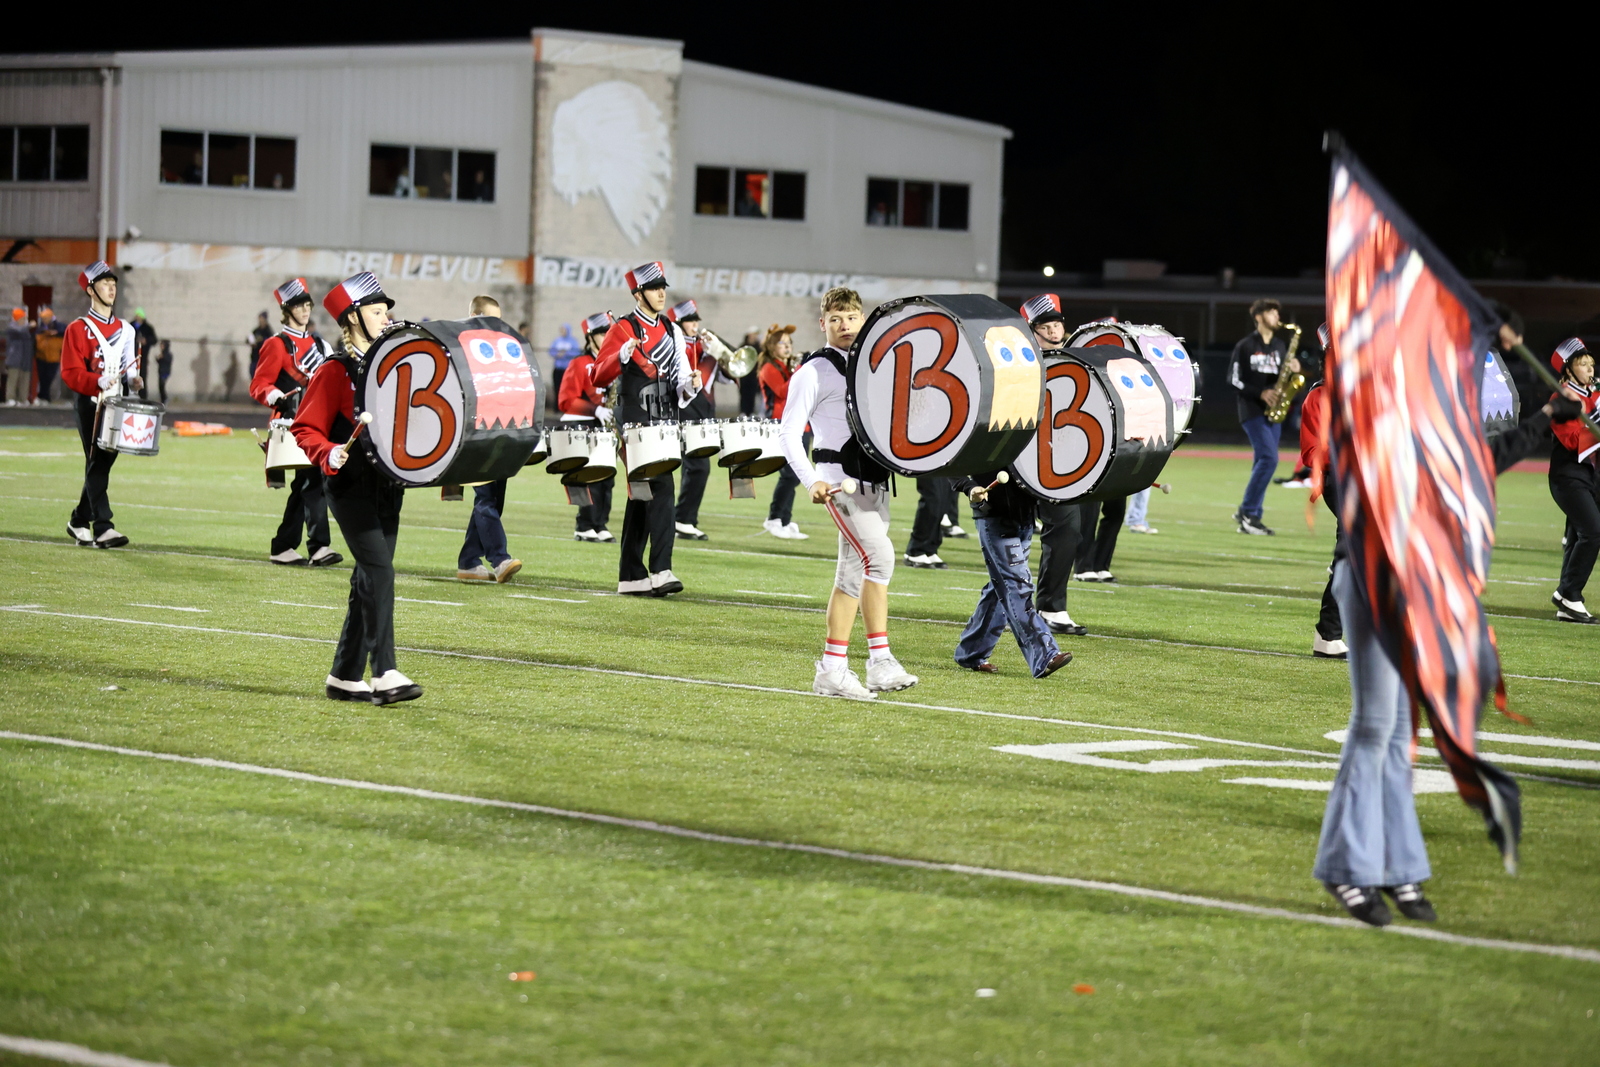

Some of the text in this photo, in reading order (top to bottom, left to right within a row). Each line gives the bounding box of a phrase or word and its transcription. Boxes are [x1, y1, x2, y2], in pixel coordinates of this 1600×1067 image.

[342, 250, 505, 283] BELLEVUE
[376, 337, 457, 472] B
[869, 311, 970, 460] B
